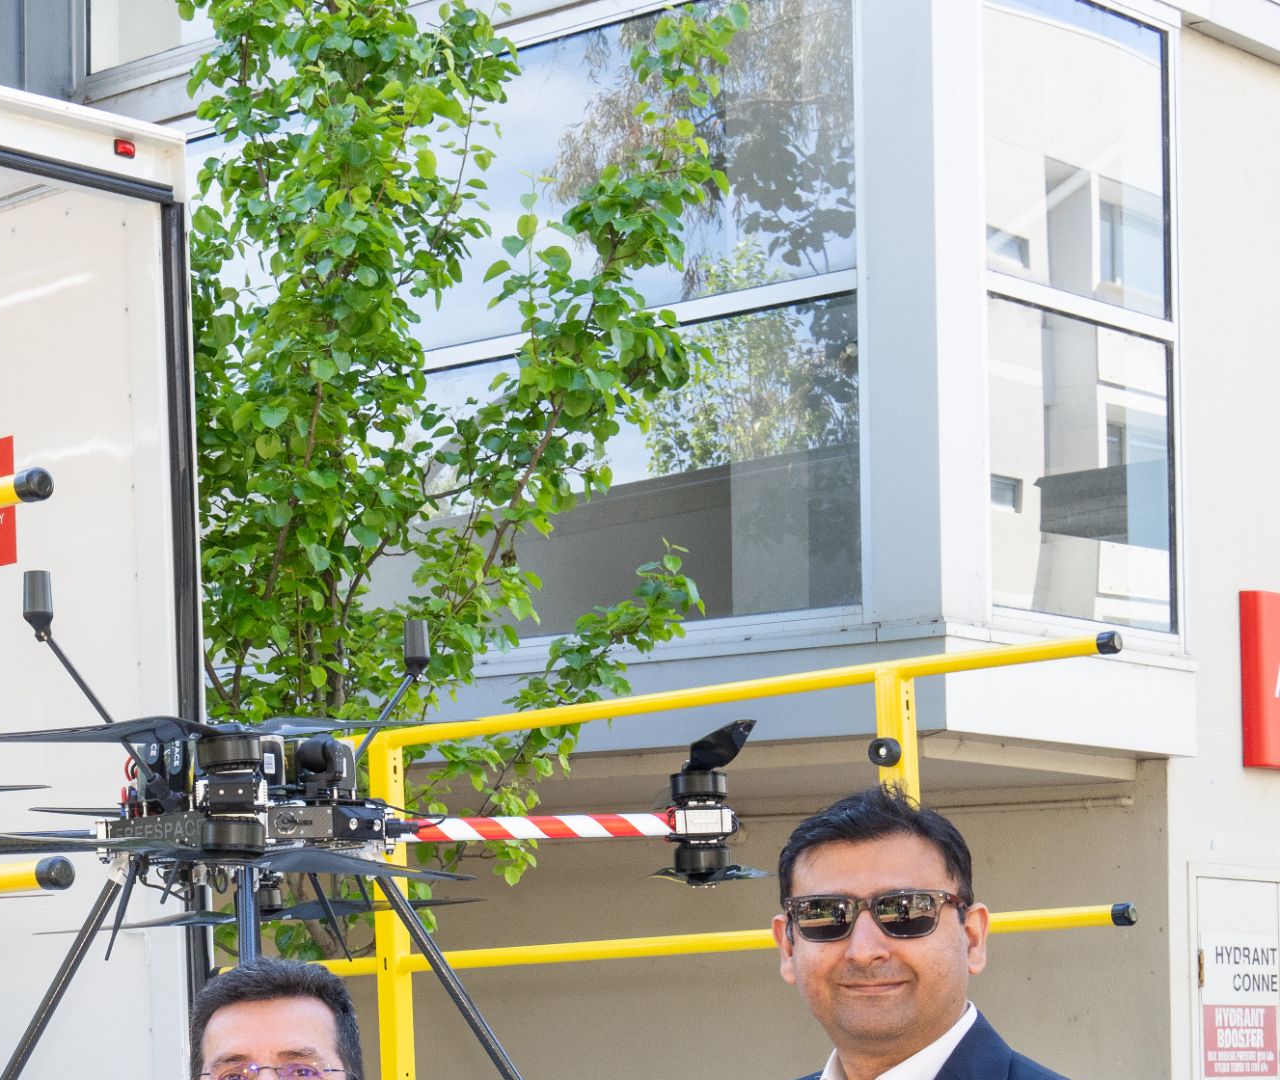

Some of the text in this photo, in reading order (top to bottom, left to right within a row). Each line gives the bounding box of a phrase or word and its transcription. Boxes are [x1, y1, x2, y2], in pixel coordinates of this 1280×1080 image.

[1215, 945, 1278, 966] HYDRANT
[1214, 1007, 1265, 1028] HYDRANT
[1216, 1028, 1265, 1049] BOOSTER
